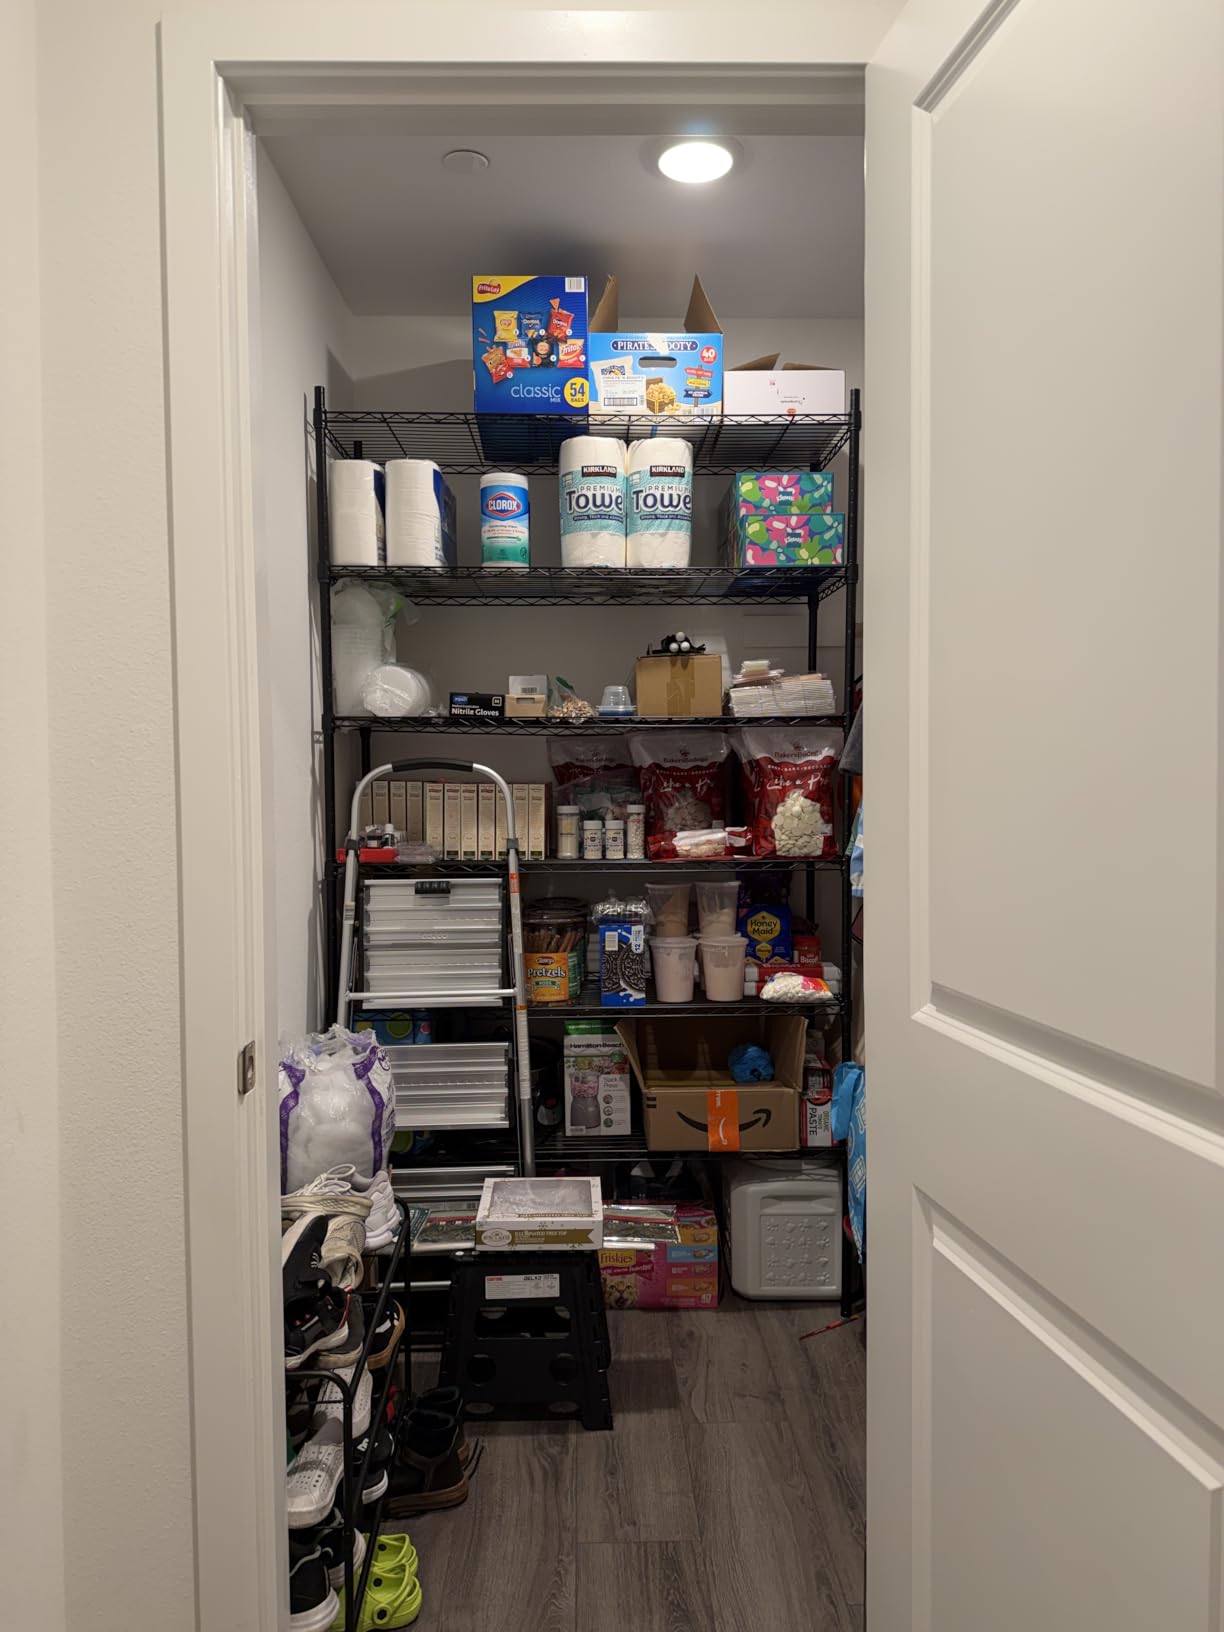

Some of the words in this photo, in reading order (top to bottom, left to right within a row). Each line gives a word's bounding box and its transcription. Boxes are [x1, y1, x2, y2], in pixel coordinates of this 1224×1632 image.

[702, 349, 716, 358] 40
[510, 383, 561, 398] classic
[569, 382, 585, 398] 54
[583, 465, 617, 474] KIRKLAND
[651, 466, 684, 474] KIRKLAND
[488, 499, 518, 511] CLOROX
[451, 707, 474, 715] Nitrile
[475, 708, 500, 717] Gloves
[750, 920, 778, 929] Honey
[528, 966, 566, 979] Pretzels
[808, 1107, 817, 1136] PASTE
